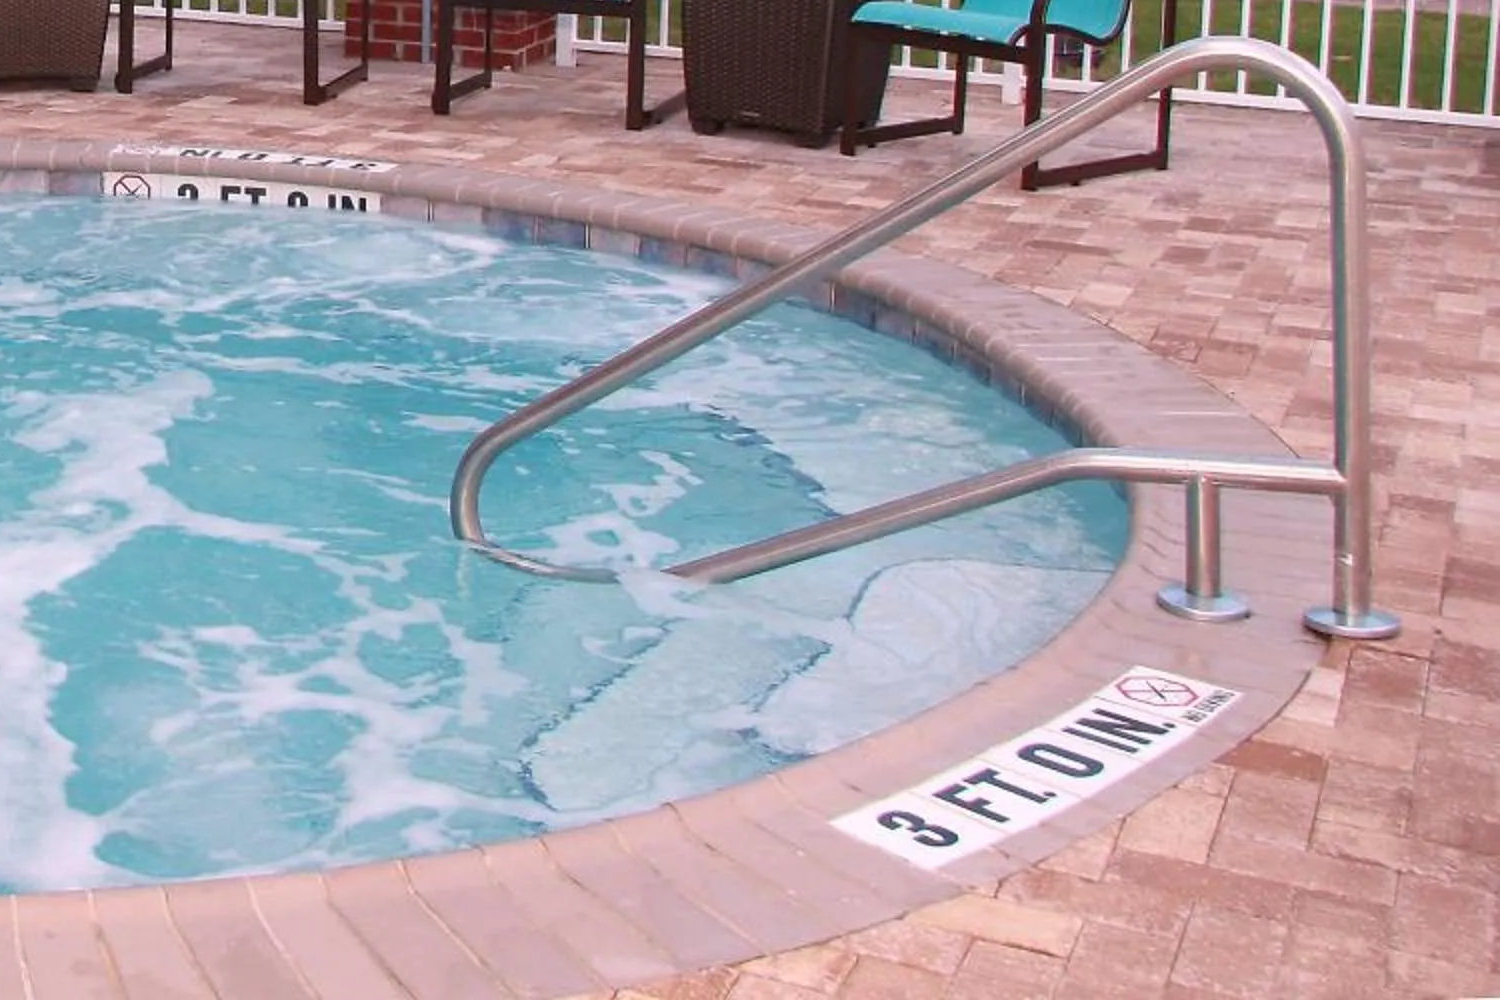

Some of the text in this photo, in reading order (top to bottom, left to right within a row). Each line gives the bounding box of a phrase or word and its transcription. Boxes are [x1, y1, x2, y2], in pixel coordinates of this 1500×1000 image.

[876, 809, 960, 848] 3
[931, 766, 1059, 824] FT.
[1060, 706, 1178, 755] IN.
